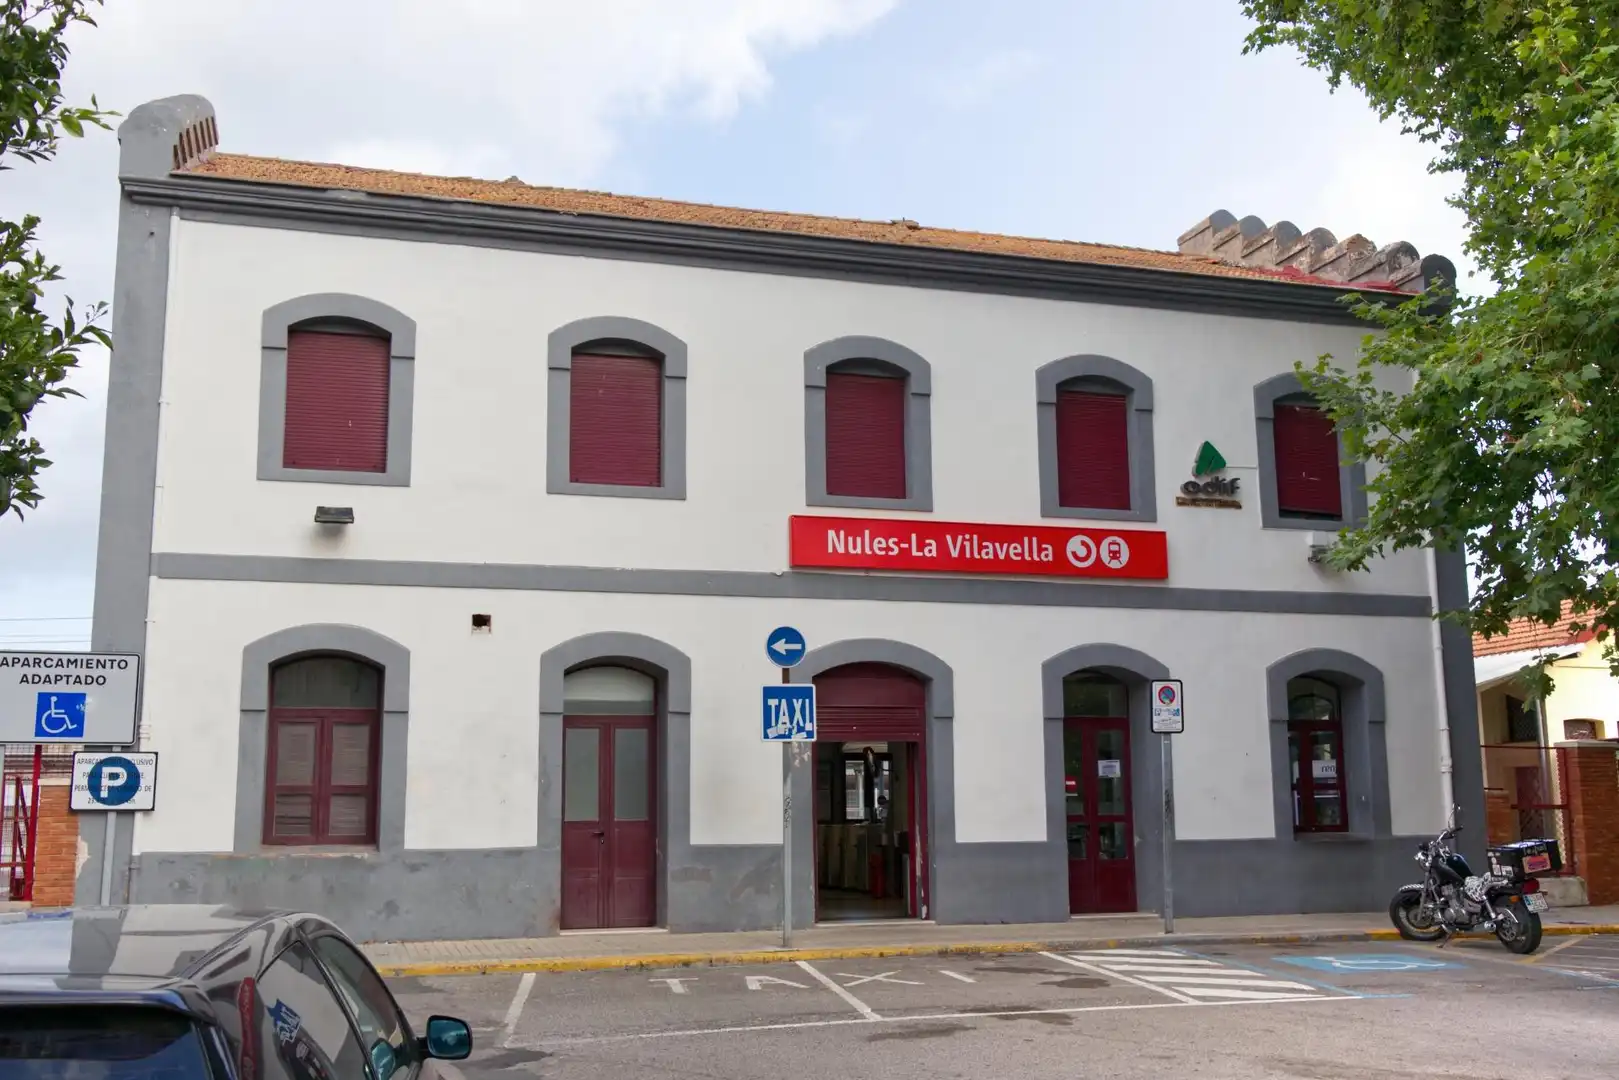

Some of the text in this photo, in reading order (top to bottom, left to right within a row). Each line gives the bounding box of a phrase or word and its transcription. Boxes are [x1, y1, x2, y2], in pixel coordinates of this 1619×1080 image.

[827, 529, 1053, 562] Nules-La Vilavella
[0, 656, 128, 670] APARCAMIENTO
[19, 673, 107, 686] ADAPTADO
[767, 698, 810, 735] TAXI
[649, 970, 977, 994] TAXI
